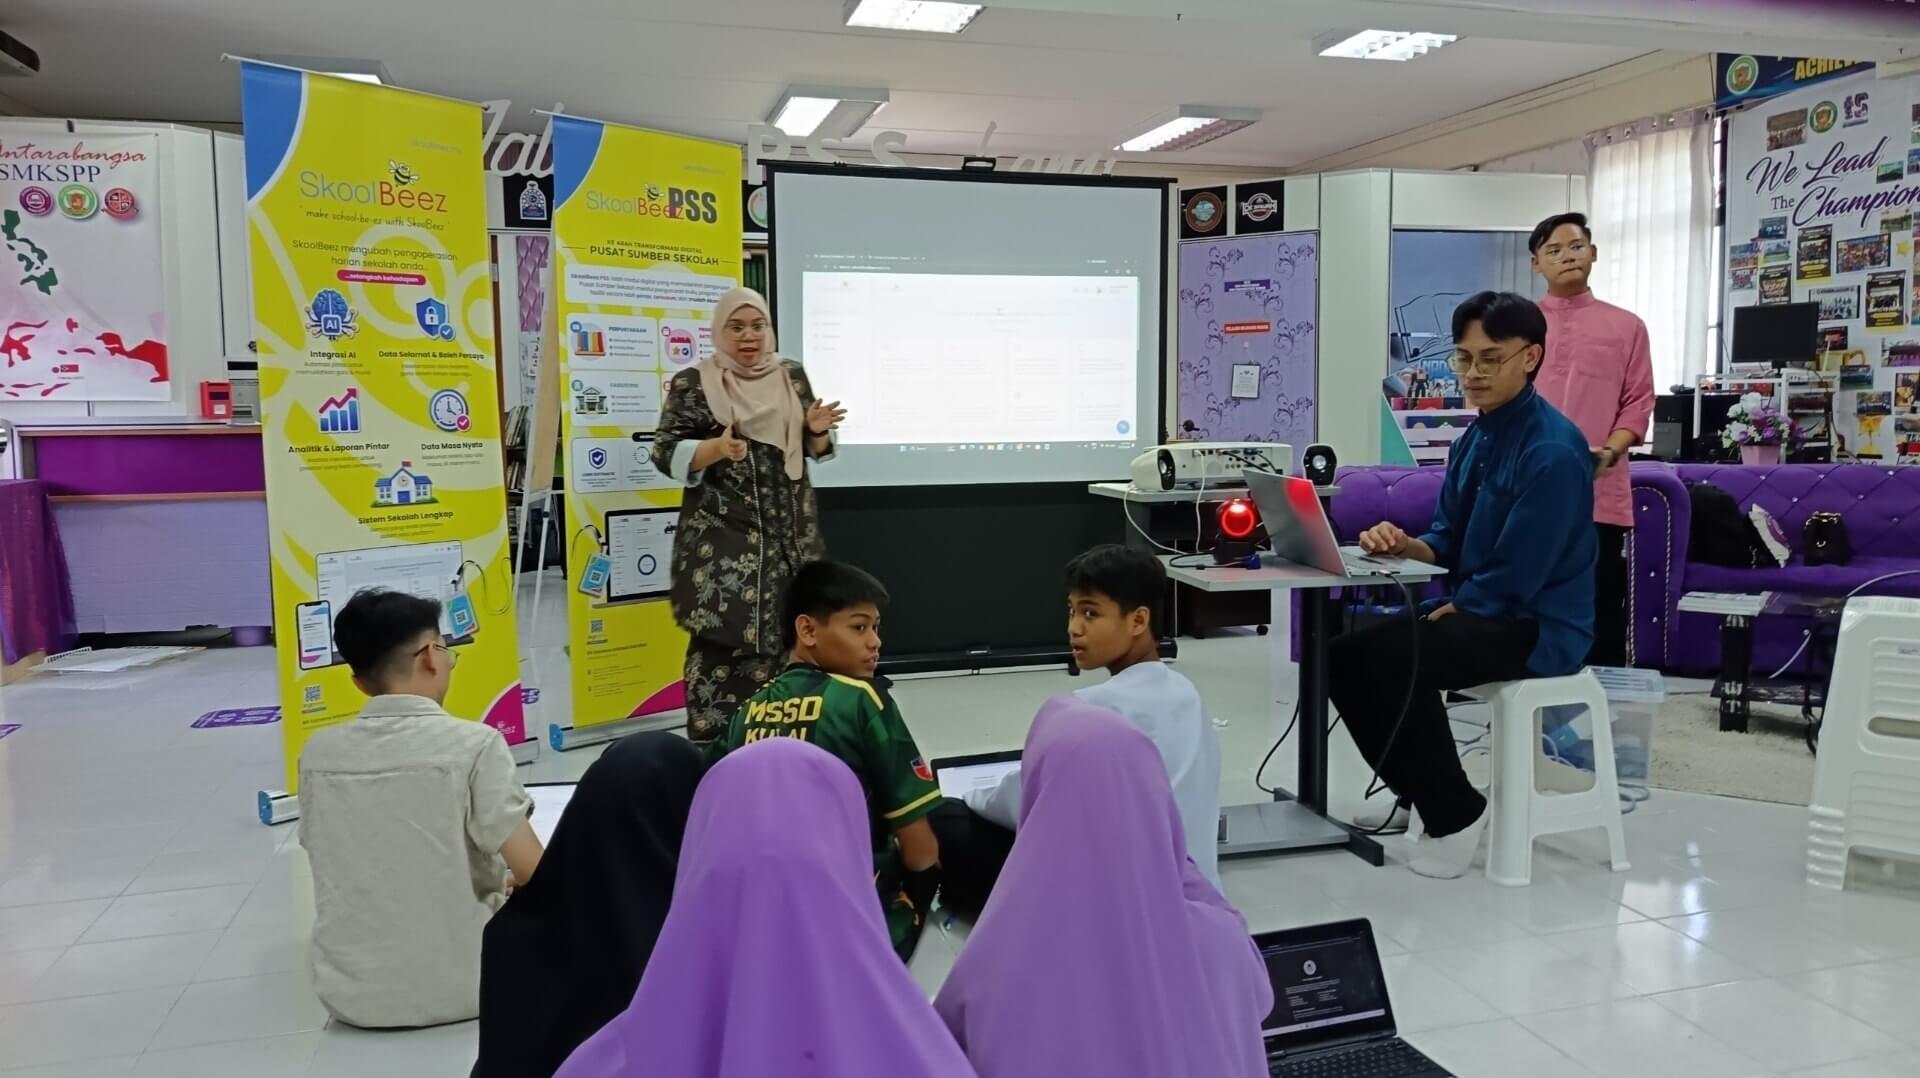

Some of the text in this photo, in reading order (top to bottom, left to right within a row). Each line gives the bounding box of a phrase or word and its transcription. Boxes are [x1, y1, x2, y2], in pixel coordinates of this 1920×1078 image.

[0, 142, 147, 170] ntarabangsa
[1746, 136, 1888, 194] We Lead
[0, 163, 101, 182] SMKSPP
[299, 171, 448, 213] SkoolBeez
[1772, 195, 1795, 210] The
[668, 187, 718, 224] PSS
[590, 246, 719, 265] PUSAT SUMBER SEKOLAH
[326, 320, 337, 329] AI
[365, 442, 390, 451] Pintar
[744, 696, 823, 725] MSSD
